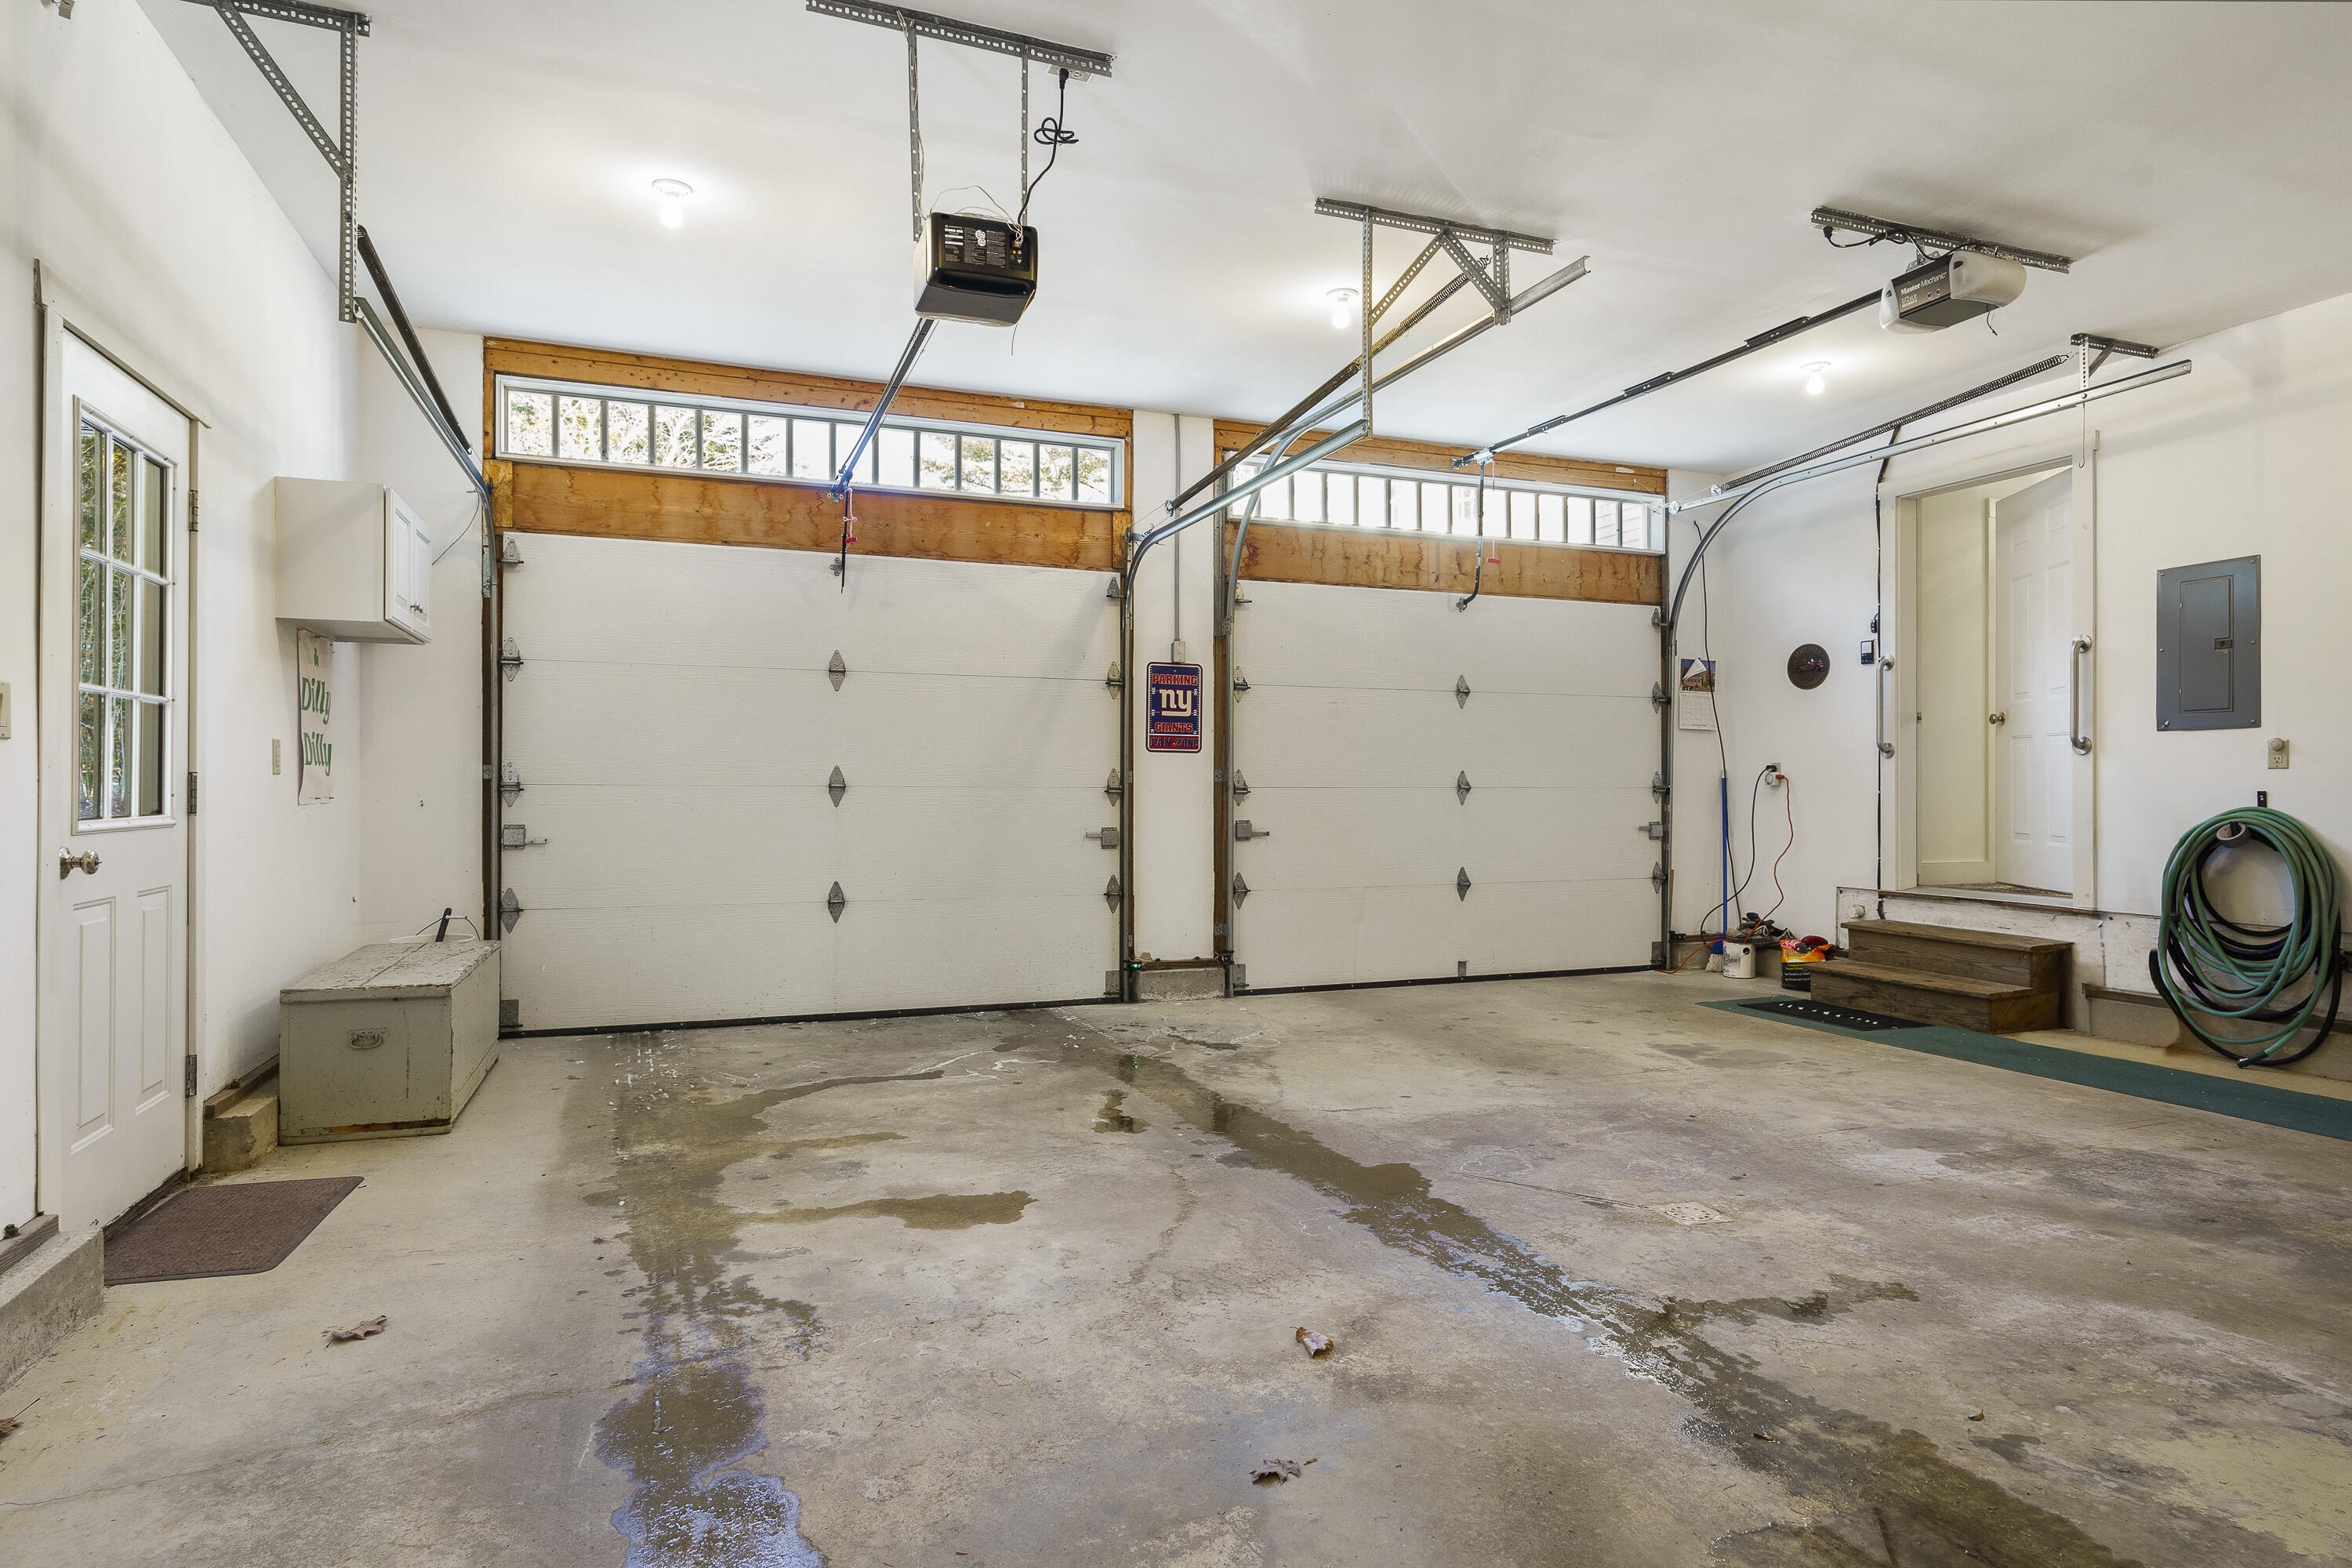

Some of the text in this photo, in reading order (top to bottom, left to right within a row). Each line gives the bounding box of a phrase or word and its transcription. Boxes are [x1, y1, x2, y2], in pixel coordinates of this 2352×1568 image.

[1152, 673, 1198, 685] PARKING
[301, 677, 332, 725] Dilly
[1155, 722, 1193, 733] GIANTS
[1150, 737, 1199, 747] FAN ZONE
[303, 731, 332, 776] Dilly
